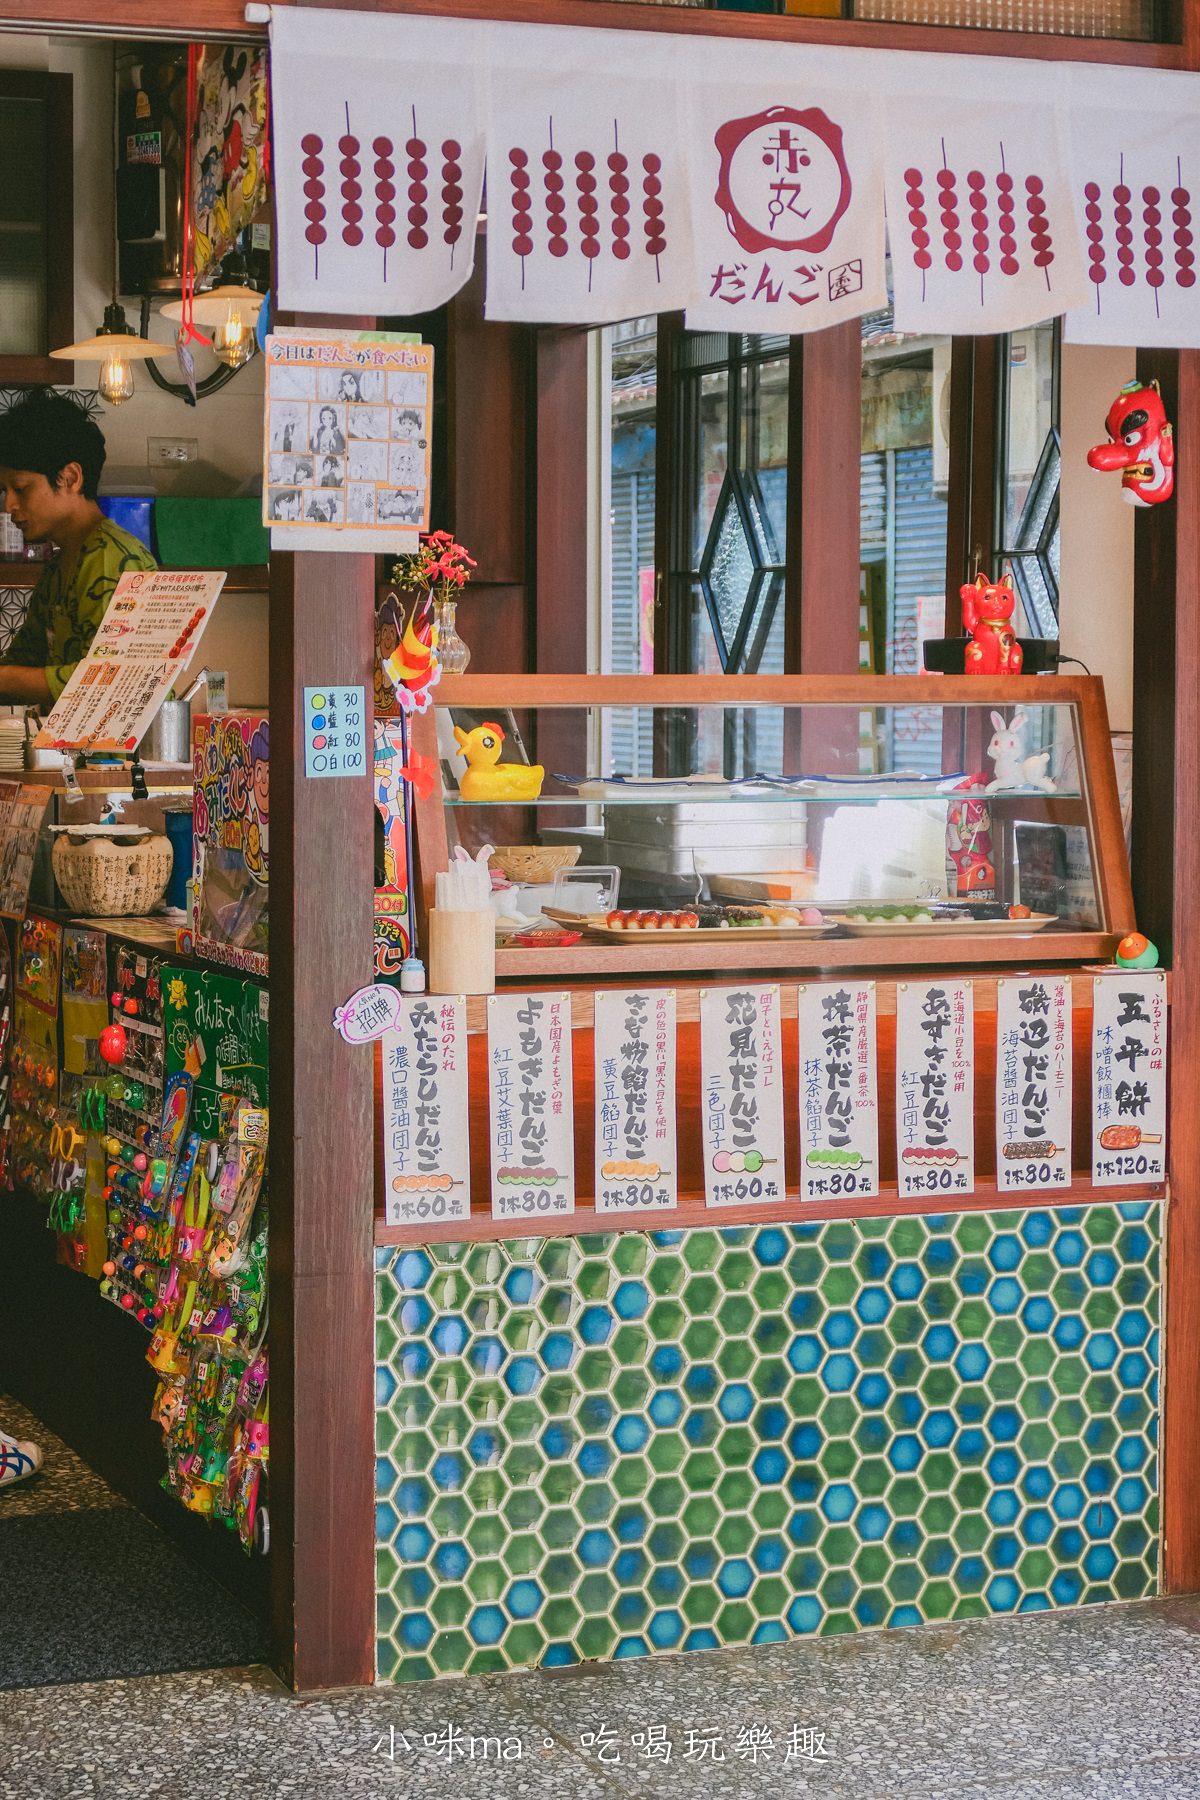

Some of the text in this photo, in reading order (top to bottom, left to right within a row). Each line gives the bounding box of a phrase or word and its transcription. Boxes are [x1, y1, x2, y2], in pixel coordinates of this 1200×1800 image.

[709, 262, 824, 306] だんご
[270, 343, 428, 368] 今日はだんごが食べたい
[328, 711, 360, 729] 藍 50
[344, 692, 358, 707] 30
[327, 732, 360, 749] 紅 80
[330, 752, 362, 770] 白 100
[356, 997, 393, 1034] 招牌
[440, 1003, 456, 1071] 秘伝のたれ
[759, 993, 774, 1087] 団子といえばコレ
[1149, 993, 1163, 1070] ふるさとの味
[516, 997, 549, 1167] よもぎだんご
[549, 1003, 563, 1115] 日本国産よもぎの葉
[620, 993, 650, 1160] きな粉餡だんご
[724, 992, 760, 1148] 花見だんご
[821, 988, 855, 1148] 抹茶だんご
[920, 987, 952, 1146] あずきだんご
[1018, 982, 1052, 1138] 磯辺だんご
[1114, 992, 1151, 1118] 五平餅
[409, 1001, 442, 1172] みたらしだんご
[706, 1074, 726, 1150] 三色団子
[804, 1058, 823, 1148] 抹茶餡団子
[901, 1070, 921, 1144] 紅豆団子
[712, 1177, 779, 1202] 1本60元
[807, 1173, 873, 1196] 1本80元
[905, 1169, 969, 1193] 1本80元
[1004, 1163, 1067, 1186] 1本80元
[1096, 1154, 1162, 1177] 1本120元
[393, 1195, 464, 1219] 1本60元
[499, 1190, 568, 1214] 1本80元
[602, 1184, 671, 1208] 1本80元
